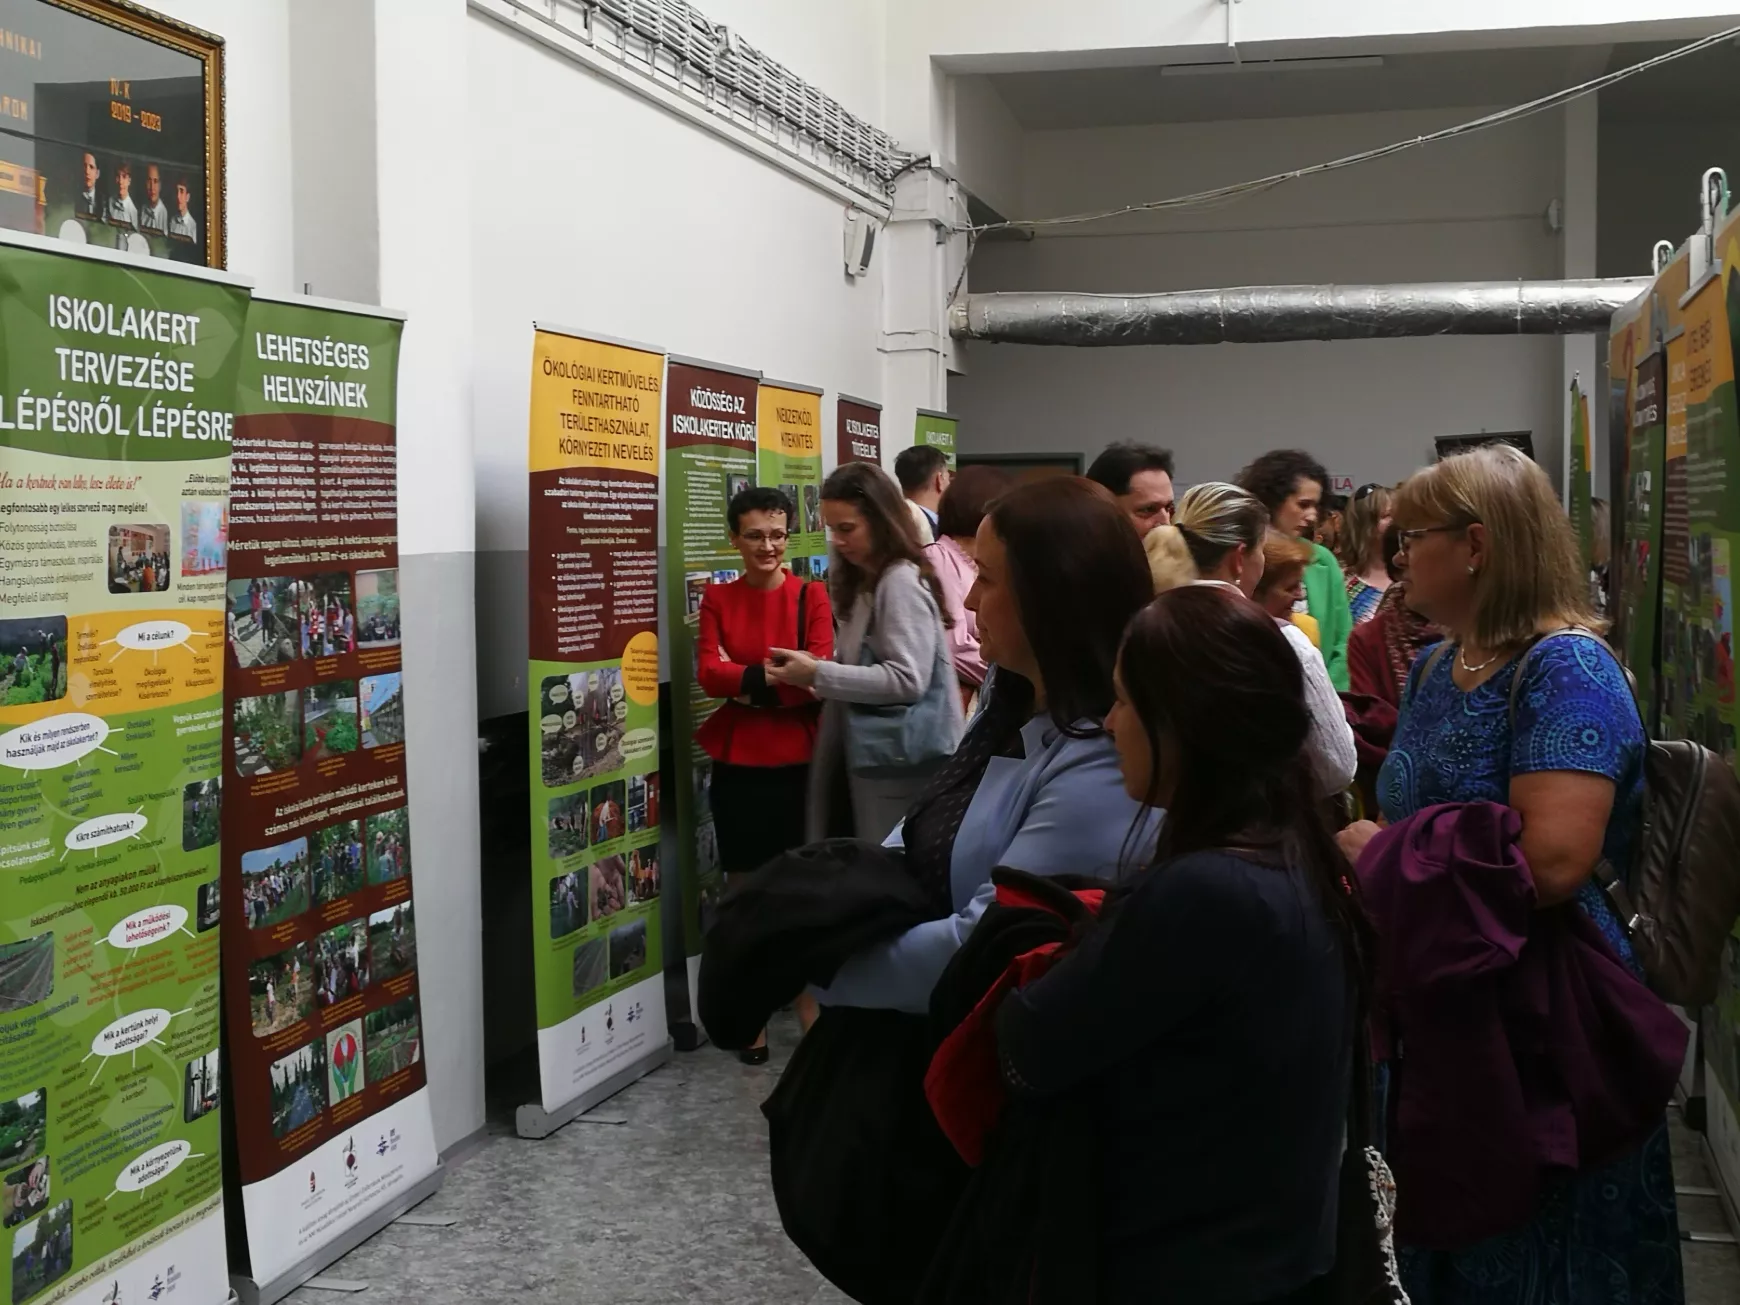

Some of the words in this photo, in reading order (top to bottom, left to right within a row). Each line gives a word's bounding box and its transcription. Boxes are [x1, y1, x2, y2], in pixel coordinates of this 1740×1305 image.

[50, 294, 200, 346] ISKOLAKERT
[256, 332, 370, 370] LEHETSÉGES
[55, 347, 195, 393] TERVEZÉSE
[543, 356, 596, 382] ÖKOLÓGIAI
[263, 374, 368, 408] HELYSZÍNEK
[572, 389, 640, 413] FENNTARTHATÓ
[690, 386, 733, 412] KÖZÖSSÉG
[734, 396, 746, 414] AZ
[0, 388, 130, 436] LÉPÉSRŐL
[138, 400, 233, 442] LÉPÉSRE
[560, 412, 651, 439] TERÜLETHASZNÁLAT,
[672, 414, 734, 439] ISKOLAKERTEK
[559, 435, 611, 458] KÖRNYEZETI
[613, 442, 654, 461] NEVELÉS
[16, 478, 24, 488] a
[26, 473, 56, 491] kertnek
[49, 505, 60, 515] egy
[77, 501, 101, 513] szervező
[102, 504, 116, 515] mag
[0, 521, 48, 535] Folytonosság
[0, 539, 25, 551] Közös
[0, 556, 39, 571] Egymásra
[138, 632, 145, 641] Mi
[20, 733, 32, 744] Kik
[33, 731, 41, 742] és
[0, 842, 31, 857] pítsünk
